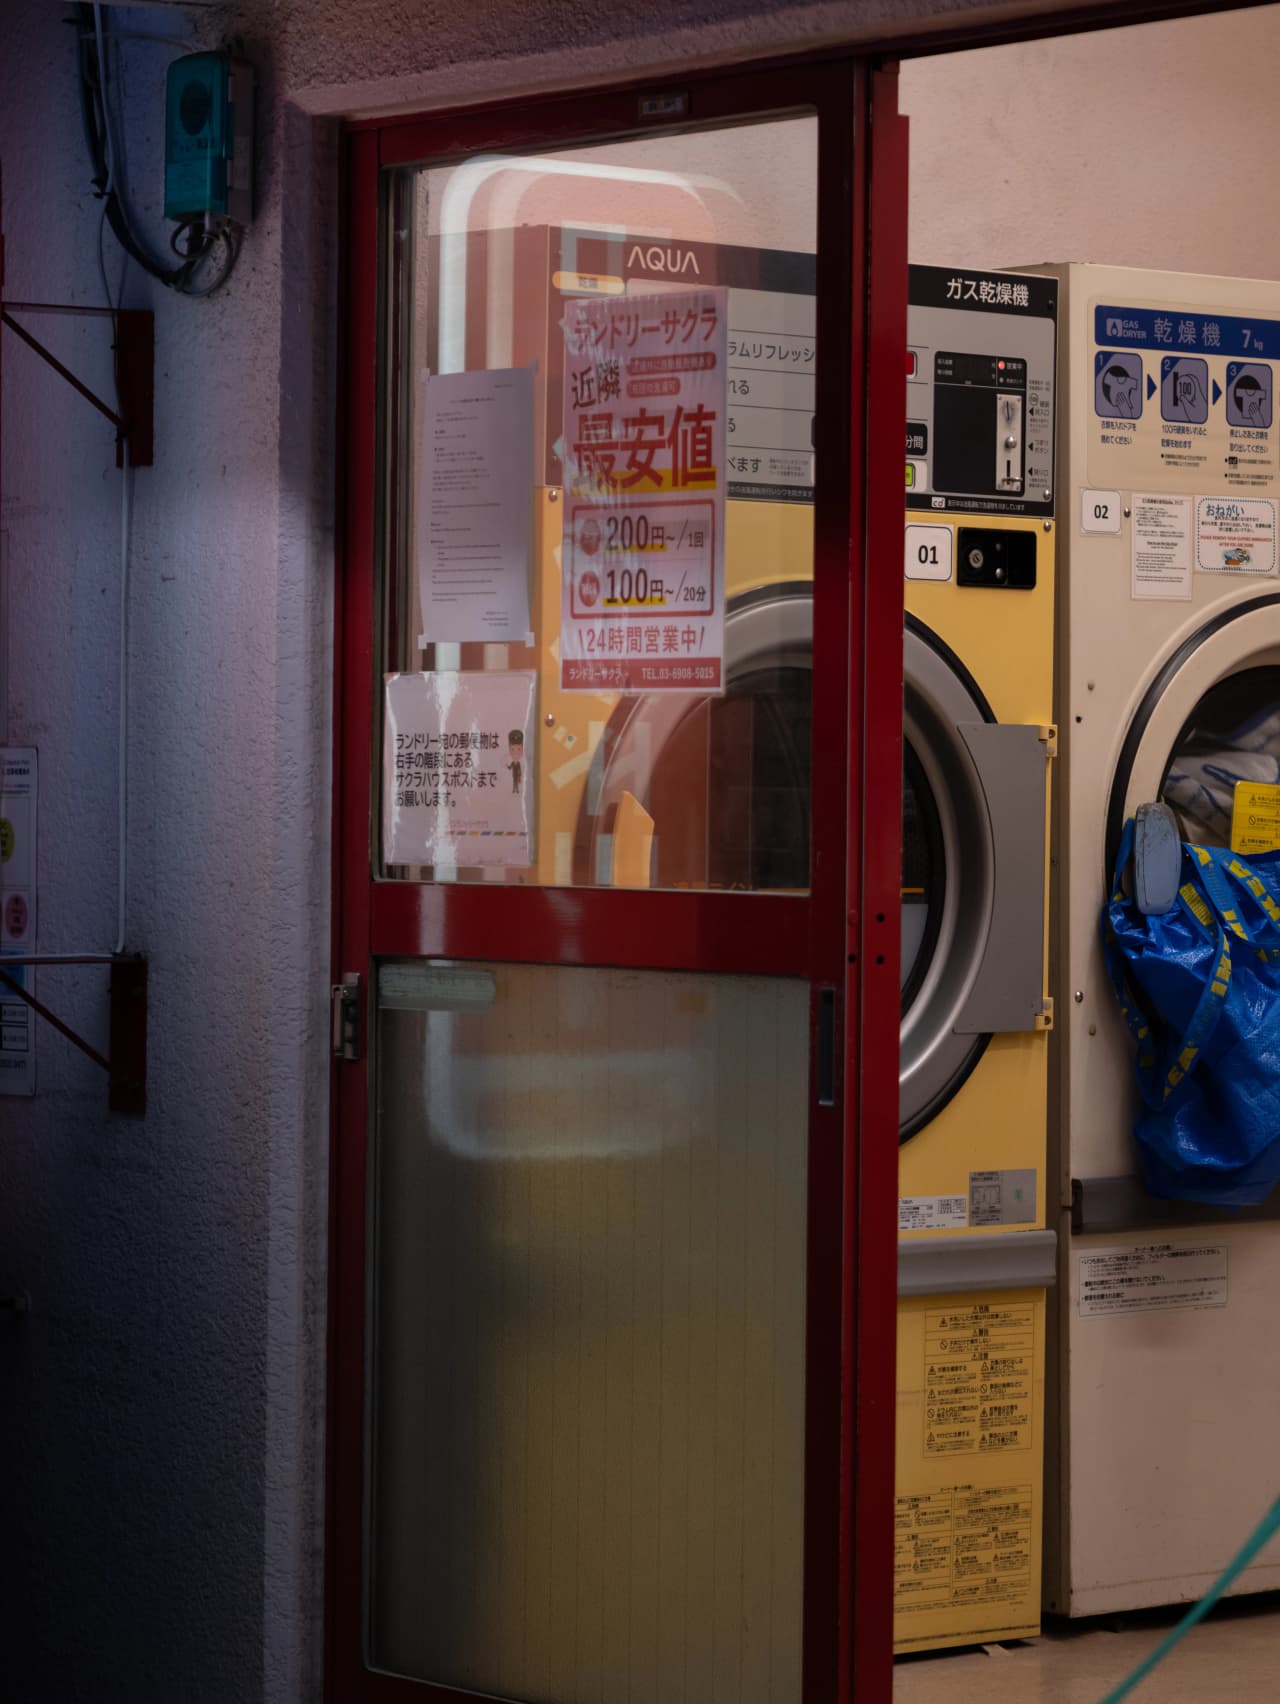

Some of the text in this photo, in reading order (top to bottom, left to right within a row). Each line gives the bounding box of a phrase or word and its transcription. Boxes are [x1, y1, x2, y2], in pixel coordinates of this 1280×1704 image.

[628, 246, 700, 275] AQUA
[947, 278, 1029, 307] ガス乾燥機
[574, 306, 718, 352] ランドリーサクラ
[1123, 320, 1139, 329] GAS
[1154, 318, 1221, 348] 乾燥機
[1123, 330, 1147, 339] DRYER
[572, 359, 621, 410] 近隣
[1179, 382, 1192, 396] 100
[573, 403, 716, 490] 最安値
[1094, 504, 1109, 519] 02
[1206, 503, 1245, 517] おねがい
[918, 544, 939, 565] 01
[396, 733, 500, 750] ランドリー宛の郵便物は
[396, 752, 475, 769] 右手の階段にある
[396, 771, 498, 788] サクラハウスポストまで
